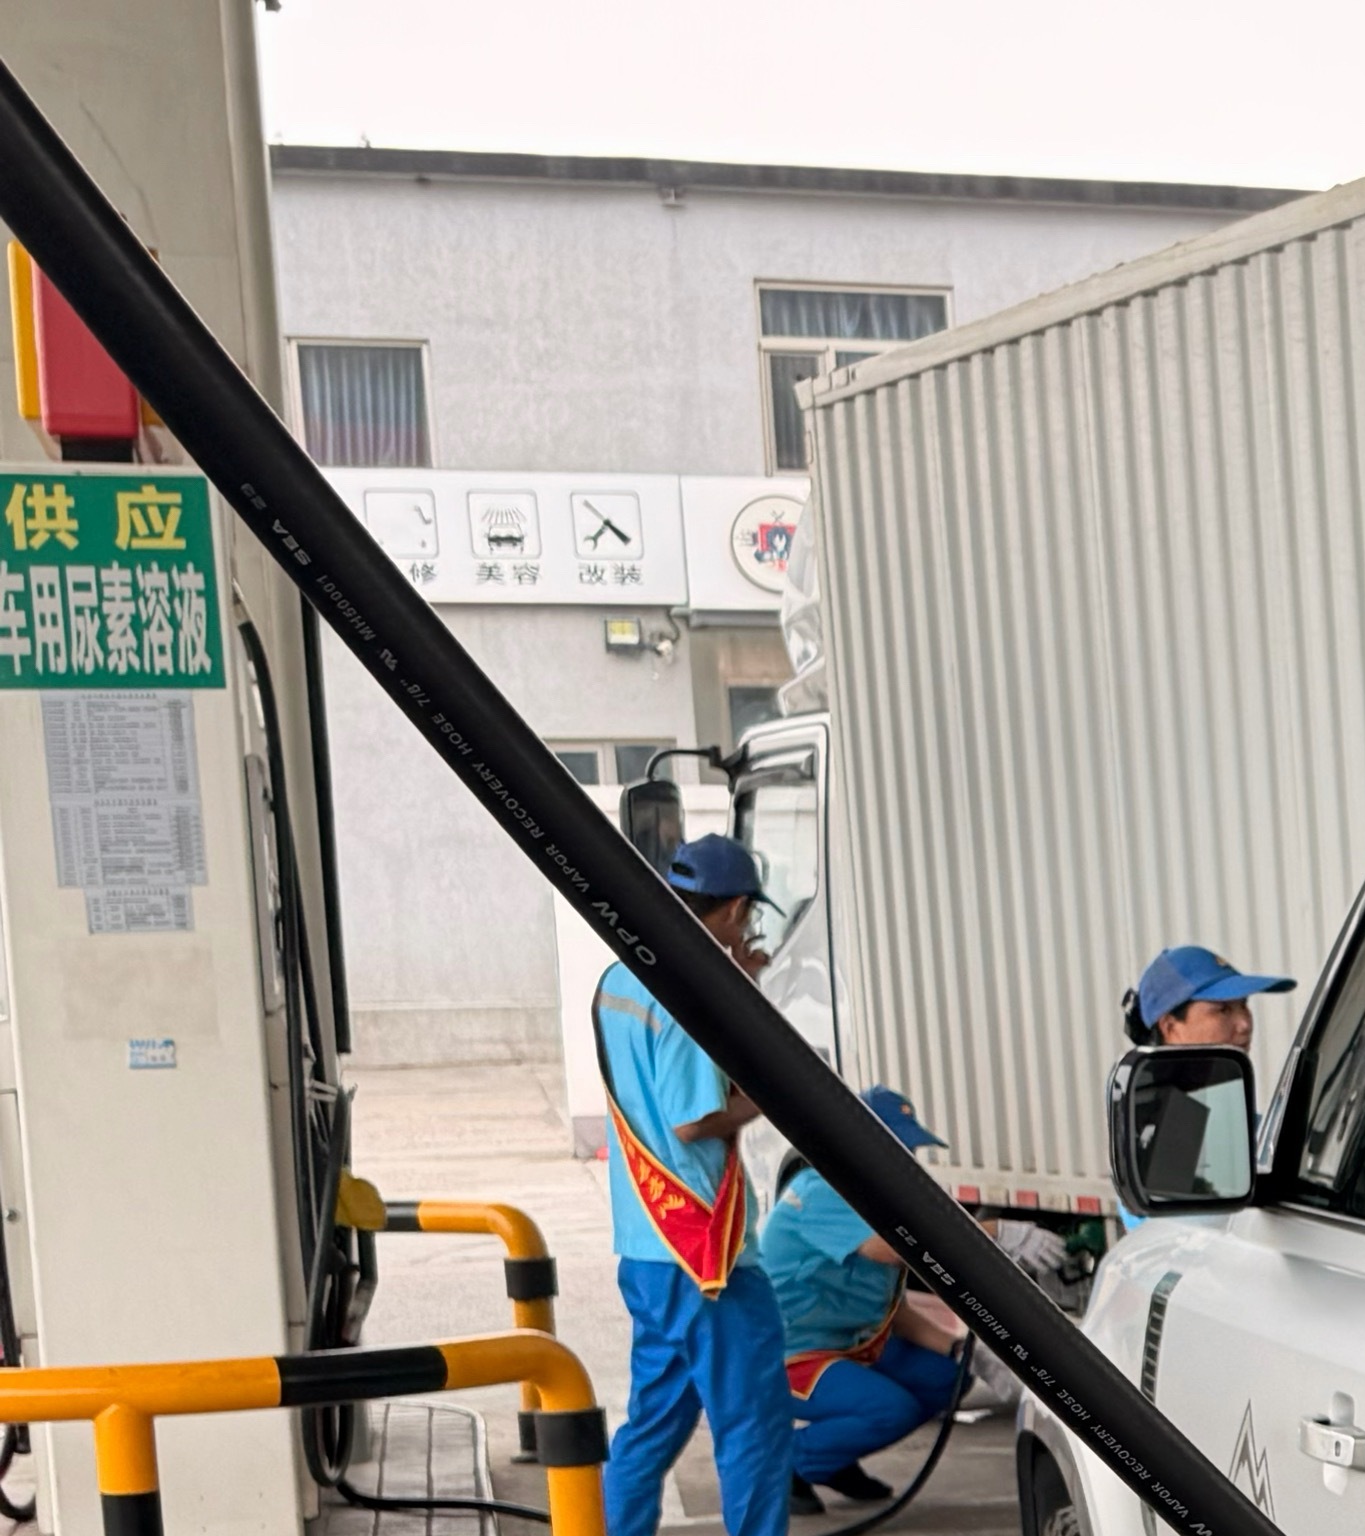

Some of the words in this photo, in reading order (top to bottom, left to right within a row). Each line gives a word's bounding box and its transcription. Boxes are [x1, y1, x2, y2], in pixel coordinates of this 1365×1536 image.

[5, 483, 187, 551] 供应
[272, 518, 312, 566] SEA
[476, 562, 541, 585] 美容
[578, 563, 643, 586] 改装
[0, 560, 212, 676] 车用尿素溶液
[431, 712, 473, 755] HOSE
[471, 762, 545, 839] RECOVERY
[545, 843, 590, 893] VAPOR
[591, 901, 657, 966] OPW
[922, 1251, 956, 1286] SEA
[1056, 1388, 1091, 1421] HOSE
[1090, 1424, 1152, 1480] RECOVERY
[1151, 1481, 1189, 1518] VAPOR
